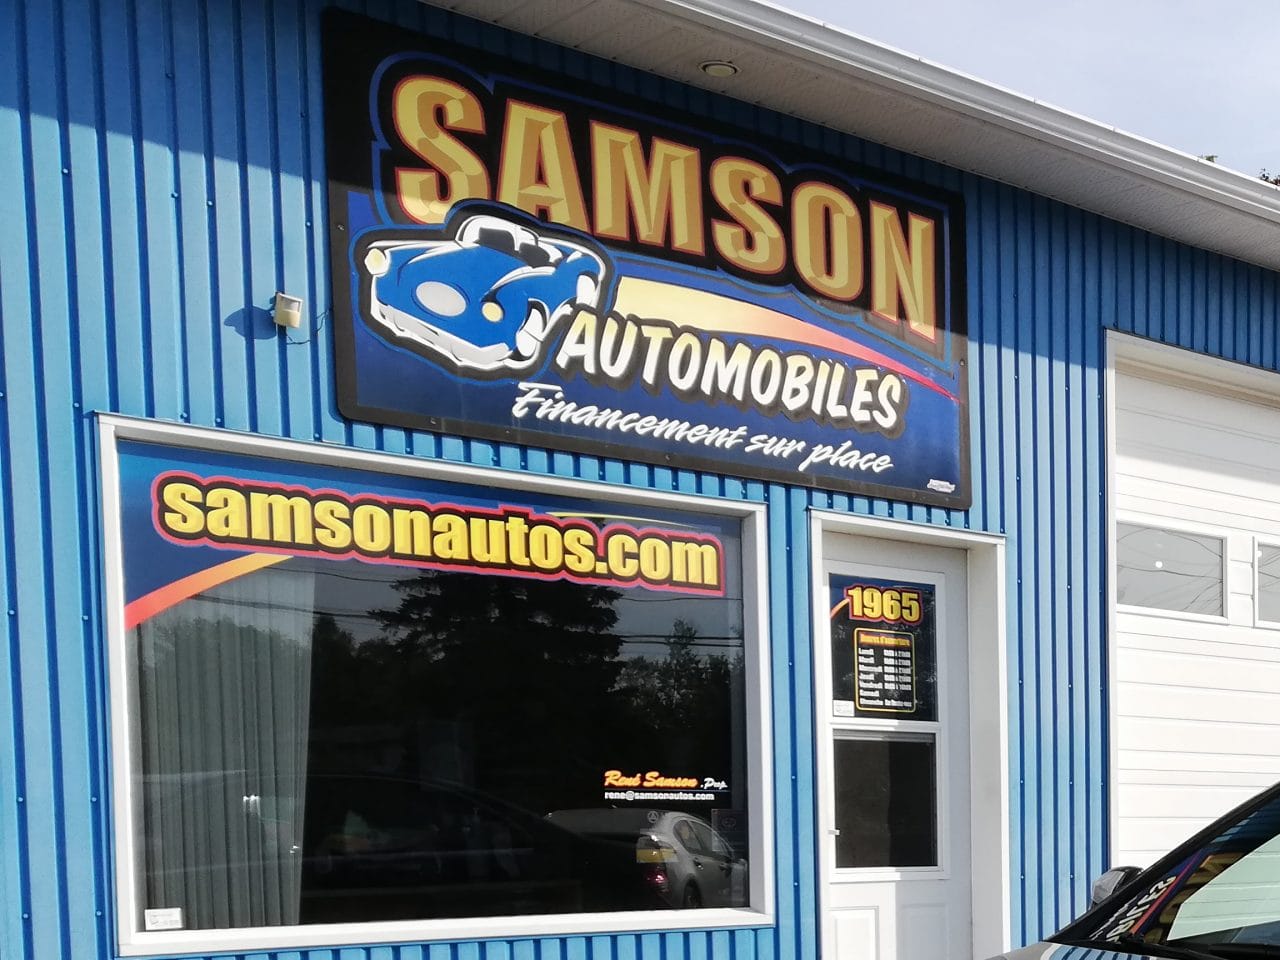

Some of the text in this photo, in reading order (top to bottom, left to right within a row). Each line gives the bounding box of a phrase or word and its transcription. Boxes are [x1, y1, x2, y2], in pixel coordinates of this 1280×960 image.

[392, 73, 938, 344] SAMSON
[556, 311, 907, 430] AUTOMOBILES
[511, 381, 894, 474] Financement sur place
[161, 482, 719, 588] samsonautos.com
[847, 585, 920, 623] 1965
[604, 769, 642, 787] René
[643, 770, 699, 788] Samson
[604, 790, 715, 801] rene@samsonautos.com
